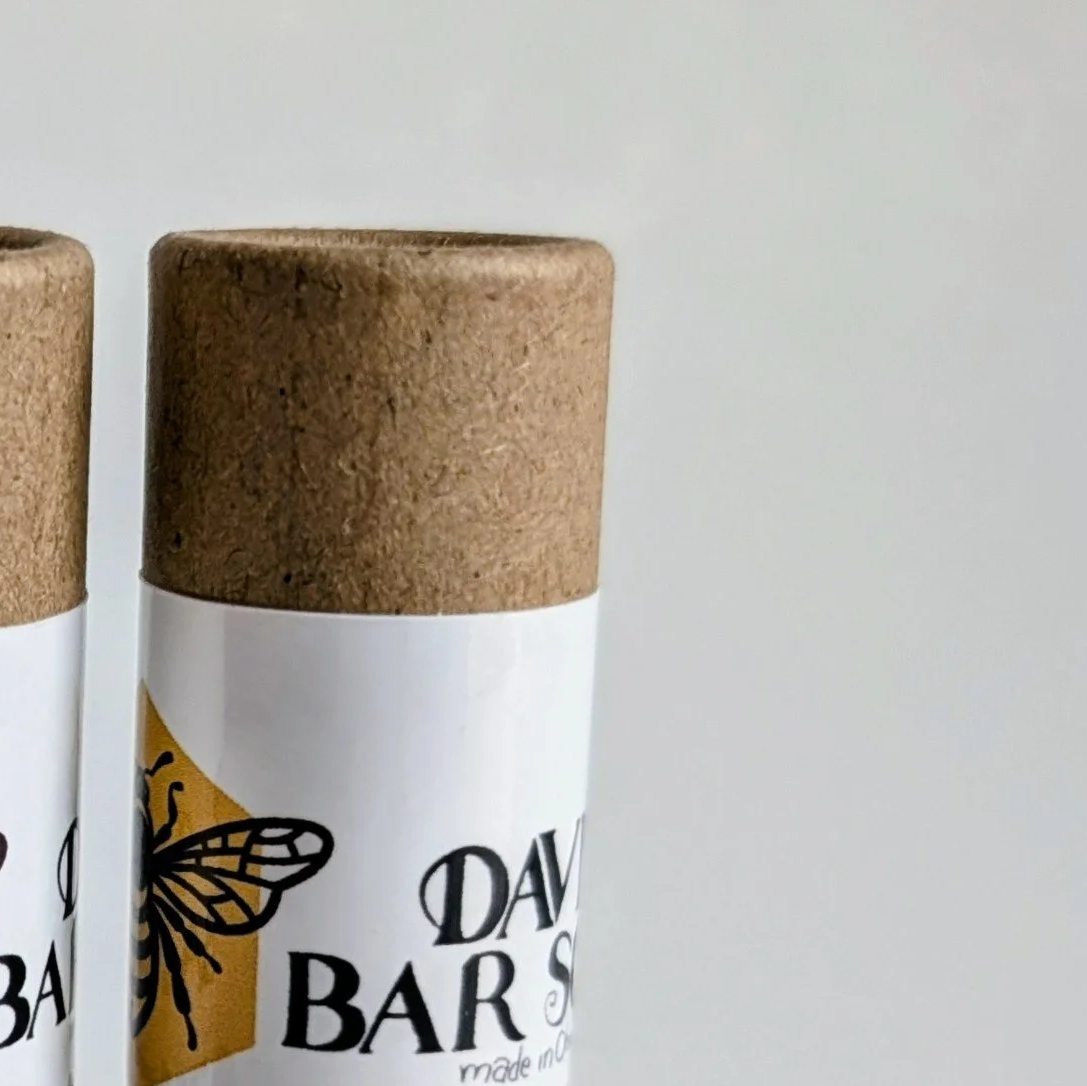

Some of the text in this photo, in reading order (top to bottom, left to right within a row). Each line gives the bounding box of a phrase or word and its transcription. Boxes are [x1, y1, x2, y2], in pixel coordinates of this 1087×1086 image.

[281, 930, 574, 1054] BAR S
[459, 1044, 531, 1084] made
[538, 1047, 554, 1073] in
